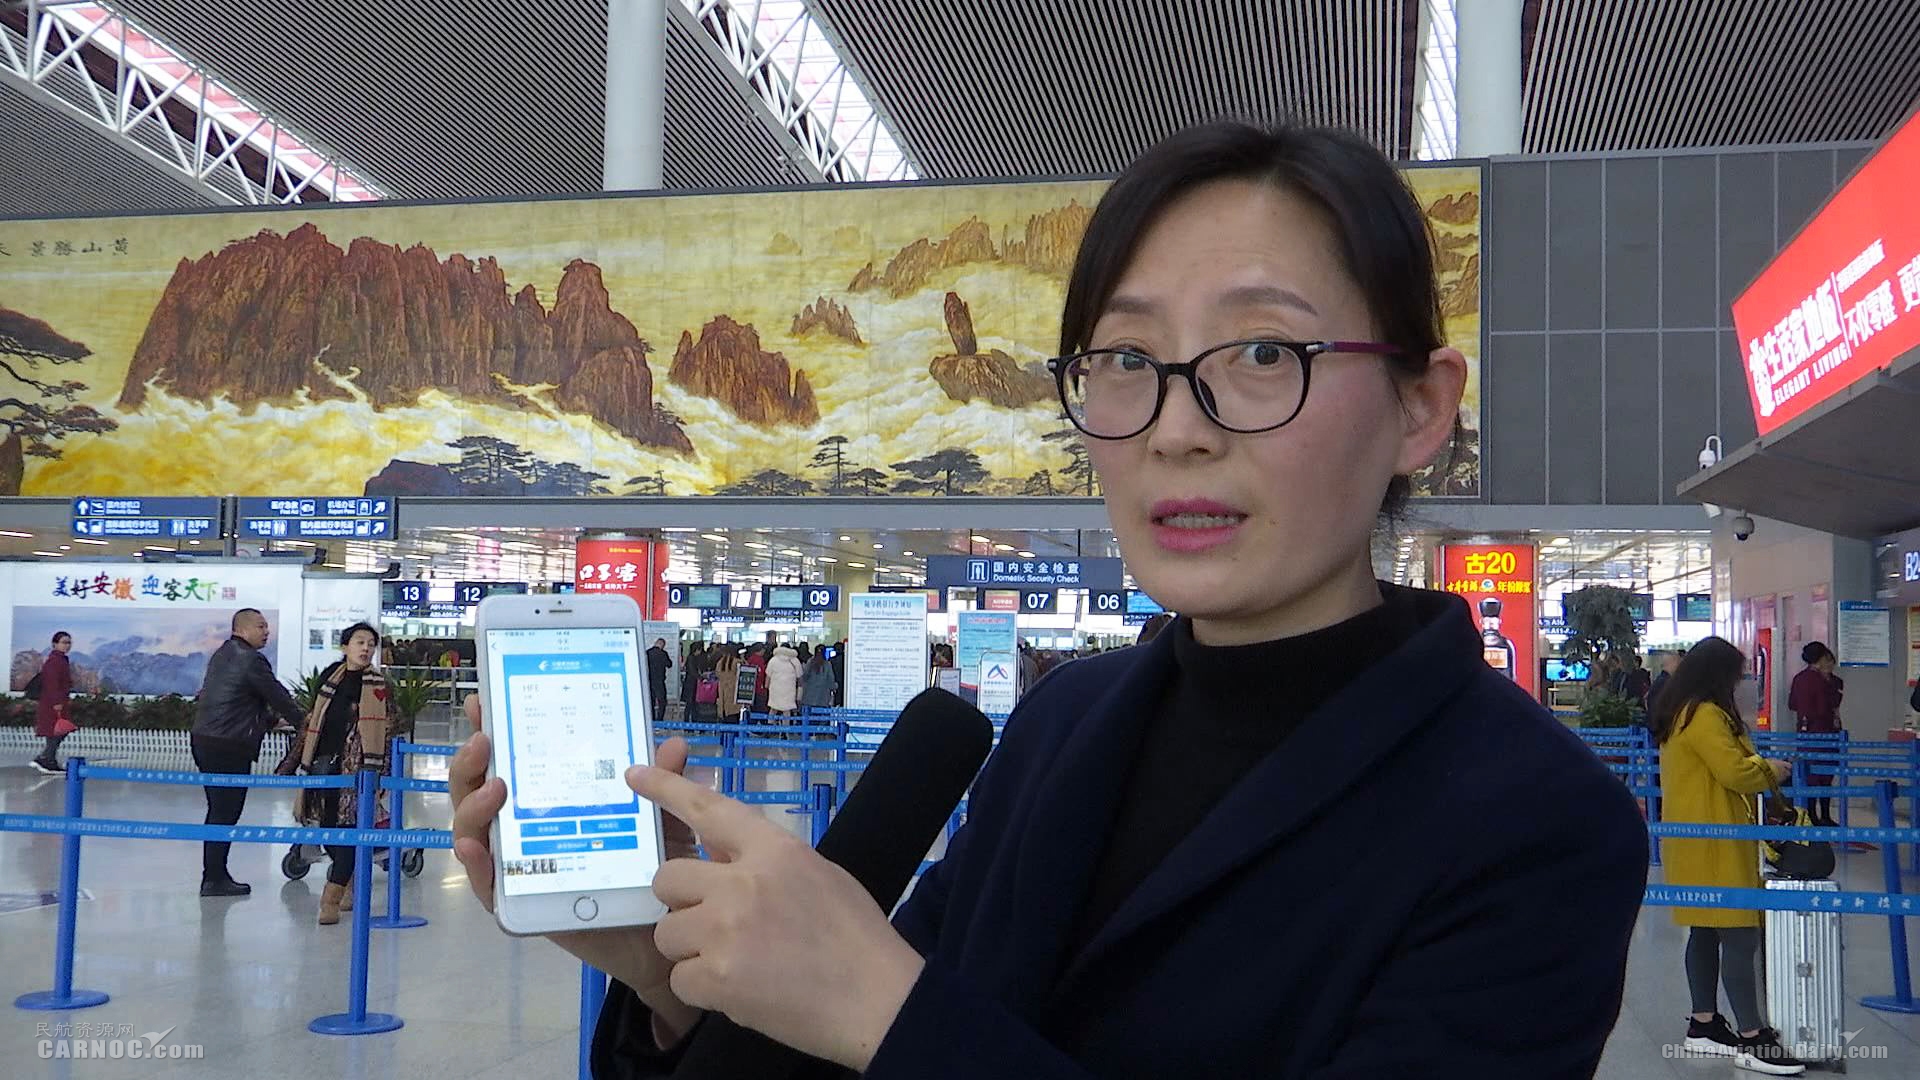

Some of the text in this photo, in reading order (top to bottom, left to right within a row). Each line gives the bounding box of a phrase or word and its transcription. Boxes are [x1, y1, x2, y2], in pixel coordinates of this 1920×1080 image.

[1774, 342, 1849, 406] ELEGANT LIVING
[993, 562, 1079, 574] 国内安全检查
[1465, 552, 1516, 574] 古20
[52, 571, 136, 601] 美好安徽
[141, 574, 219, 601] 迎客天下
[993, 574, 1080, 584] Domestic Security Check
[402, 586, 419, 601] 13
[463, 587, 480, 602] 12
[671, 588, 681, 604] 0
[809, 590, 830, 605] 09
[1027, 593, 1049, 609] 07
[1098, 594, 1120, 609] 06
[1676, 891, 1723, 903] AIRPORT
